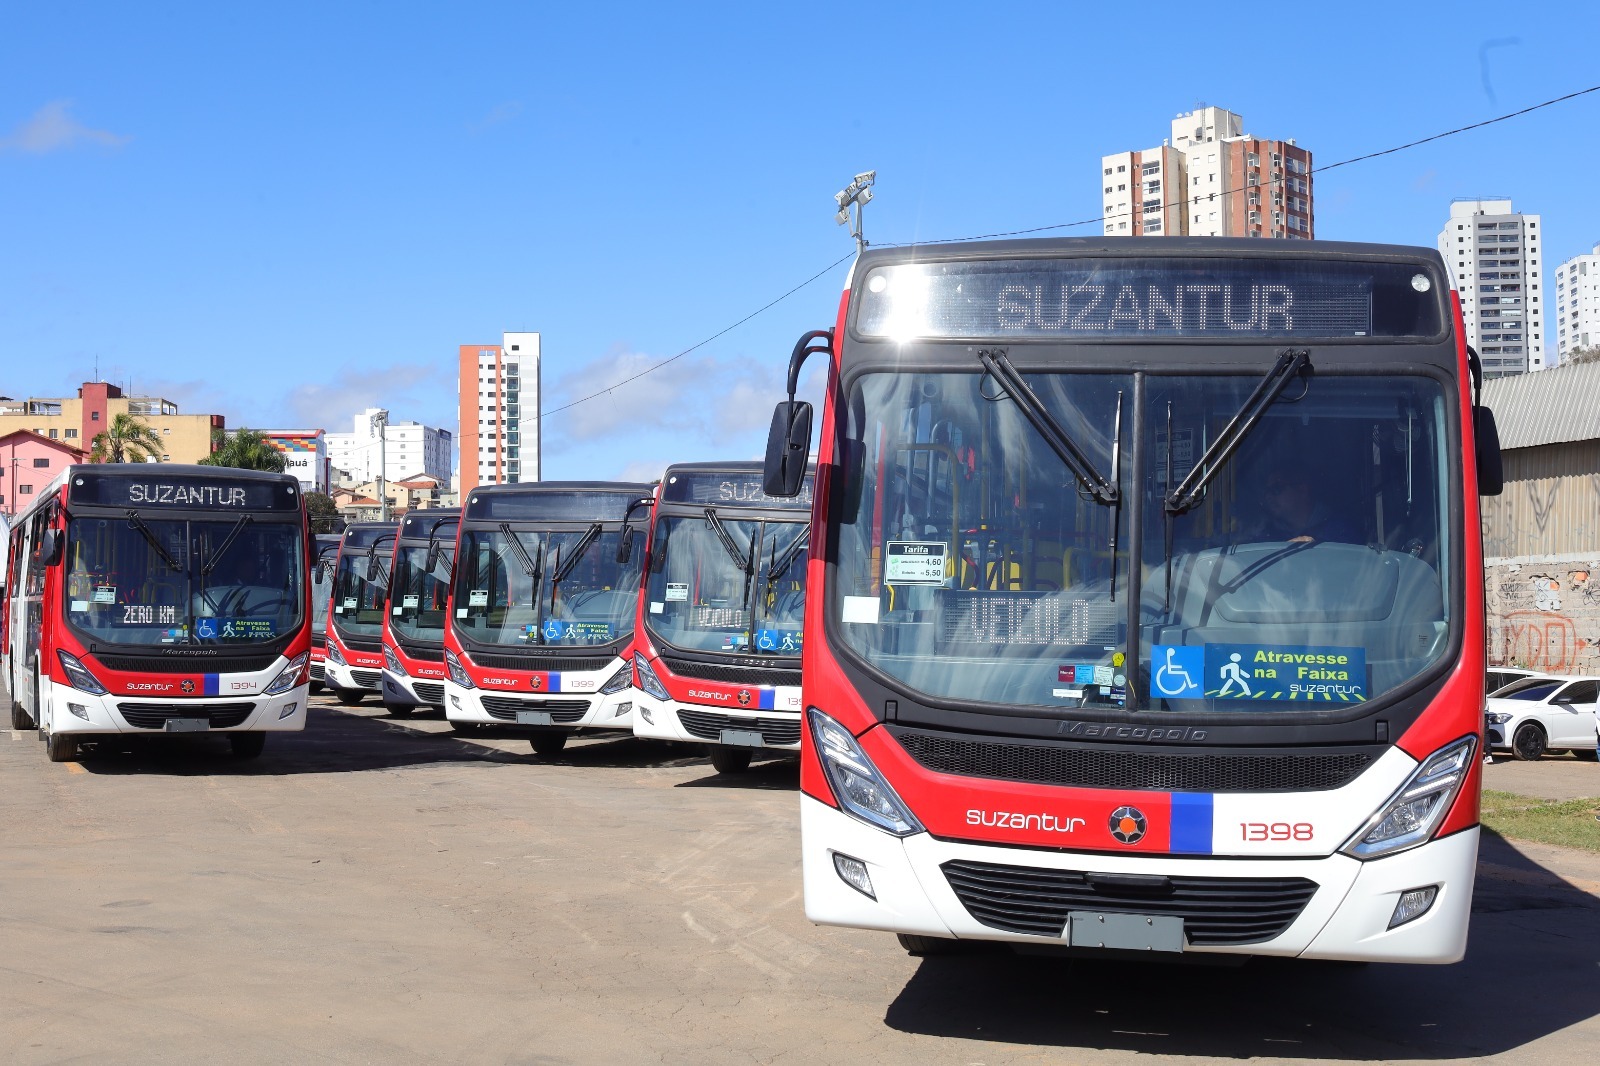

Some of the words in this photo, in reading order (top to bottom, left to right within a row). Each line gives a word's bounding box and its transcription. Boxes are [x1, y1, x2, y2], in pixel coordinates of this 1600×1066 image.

[998, 284, 1293, 330] SUZANTUR
[129, 483, 246, 506] SUZANTUR
[903, 545, 929, 554] Tarifa
[925, 558, 942, 566] 4,60
[925, 569, 941, 577] 5,50
[123, 605, 153, 624] ZERO
[159, 605, 175, 624] KM
[698, 607, 742, 628] VEICULO
[971, 597, 1089, 645] VEICULO
[1253, 650, 1348, 665] Atravesse
[483, 677, 518, 685] suzantur
[1254, 668, 1277, 679] na
[1297, 667, 1348, 681] Faixa
[126, 682, 174, 691] suzantur
[230, 681, 257, 690] 1394
[571, 680, 595, 688] 1399
[1289, 683, 1362, 694] suzantur
[688, 688, 732, 700] suzantur
[1056, 720, 1208, 742] Marcopolo
[965, 809, 1086, 833] suzantur
[1239, 822, 1314, 841] 1398
